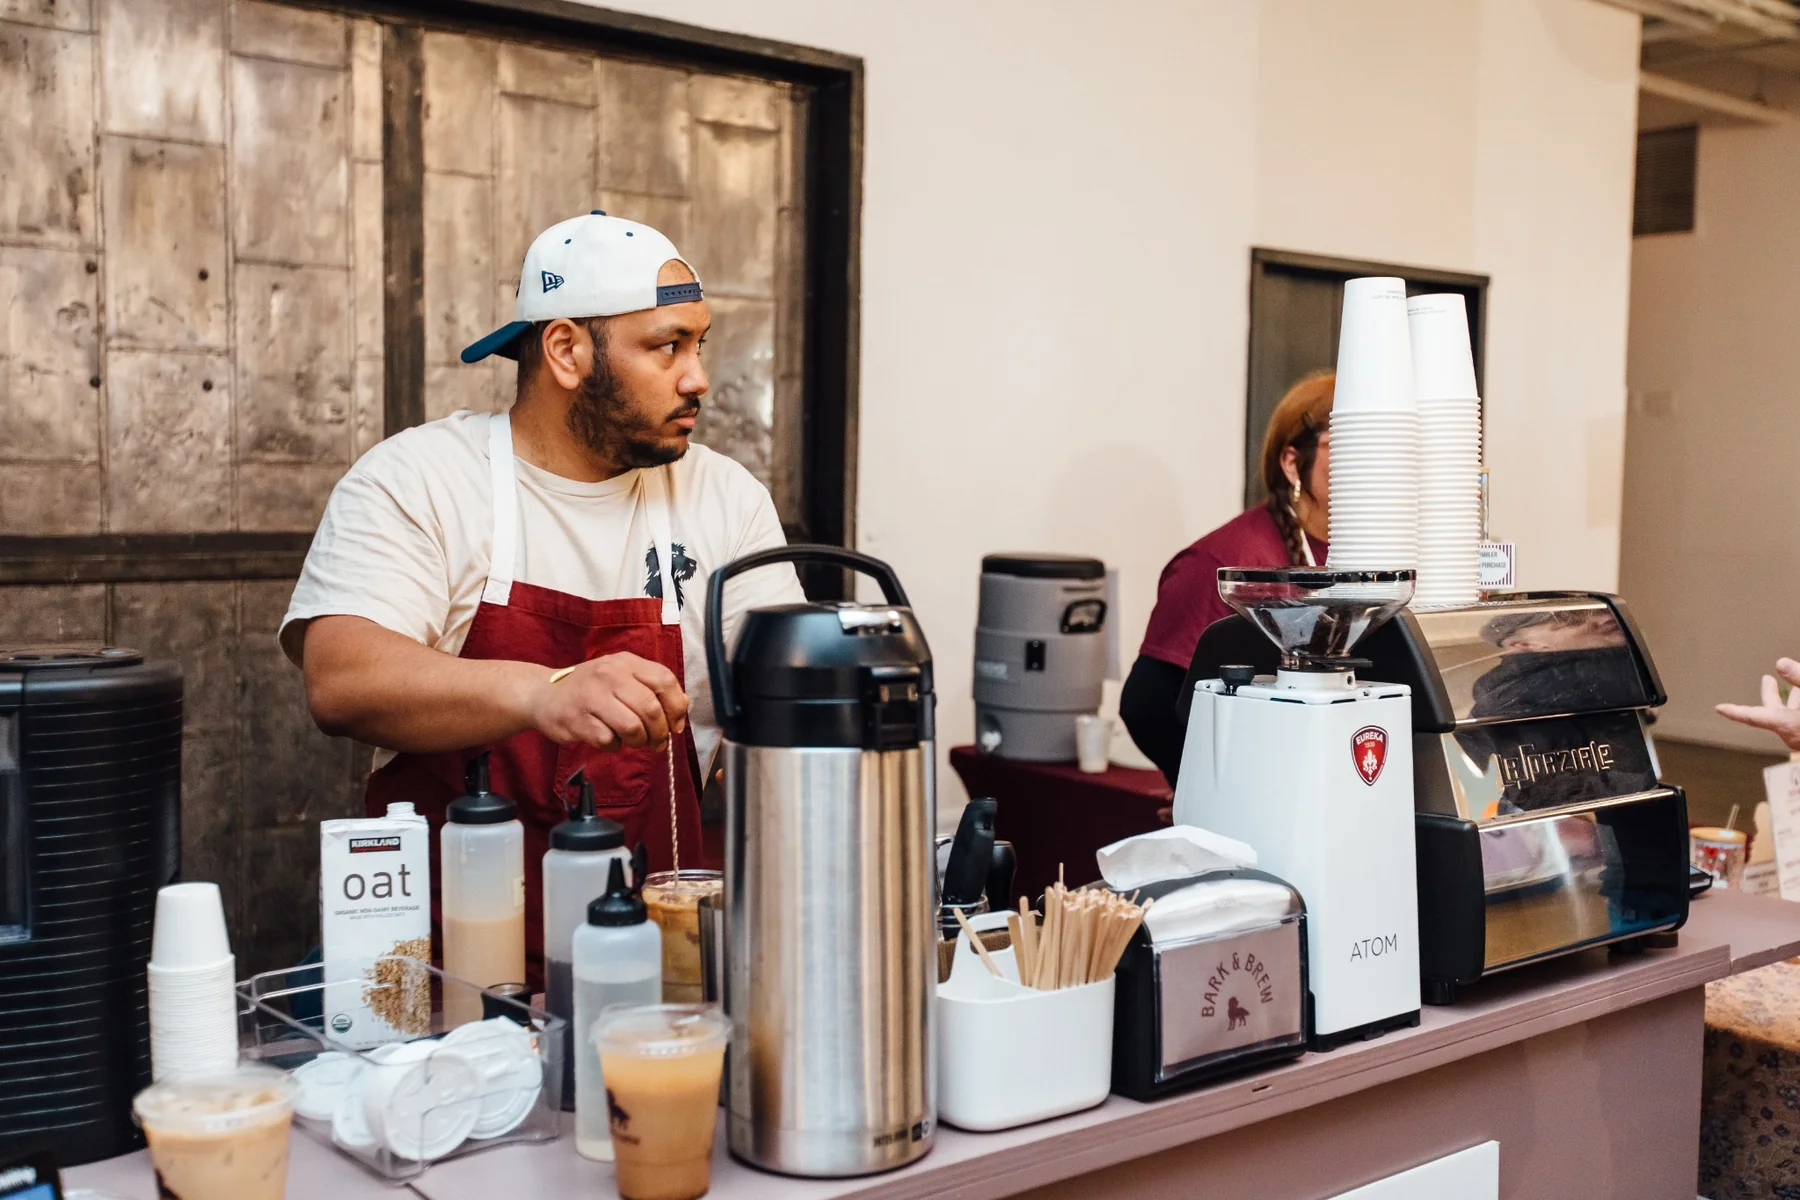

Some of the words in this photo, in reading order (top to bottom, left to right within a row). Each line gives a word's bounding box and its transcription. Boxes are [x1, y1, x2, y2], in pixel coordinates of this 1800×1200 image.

[1355, 731, 1383, 745] EUREKA
[351, 838, 400, 848] KIRKLAND
[343, 863, 411, 900] oat
[1350, 933, 1397, 962] ATOM
[1201, 961, 1230, 1018] BARK
[1232, 952, 1241, 970] &
[1244, 953, 1273, 1004] BREW
